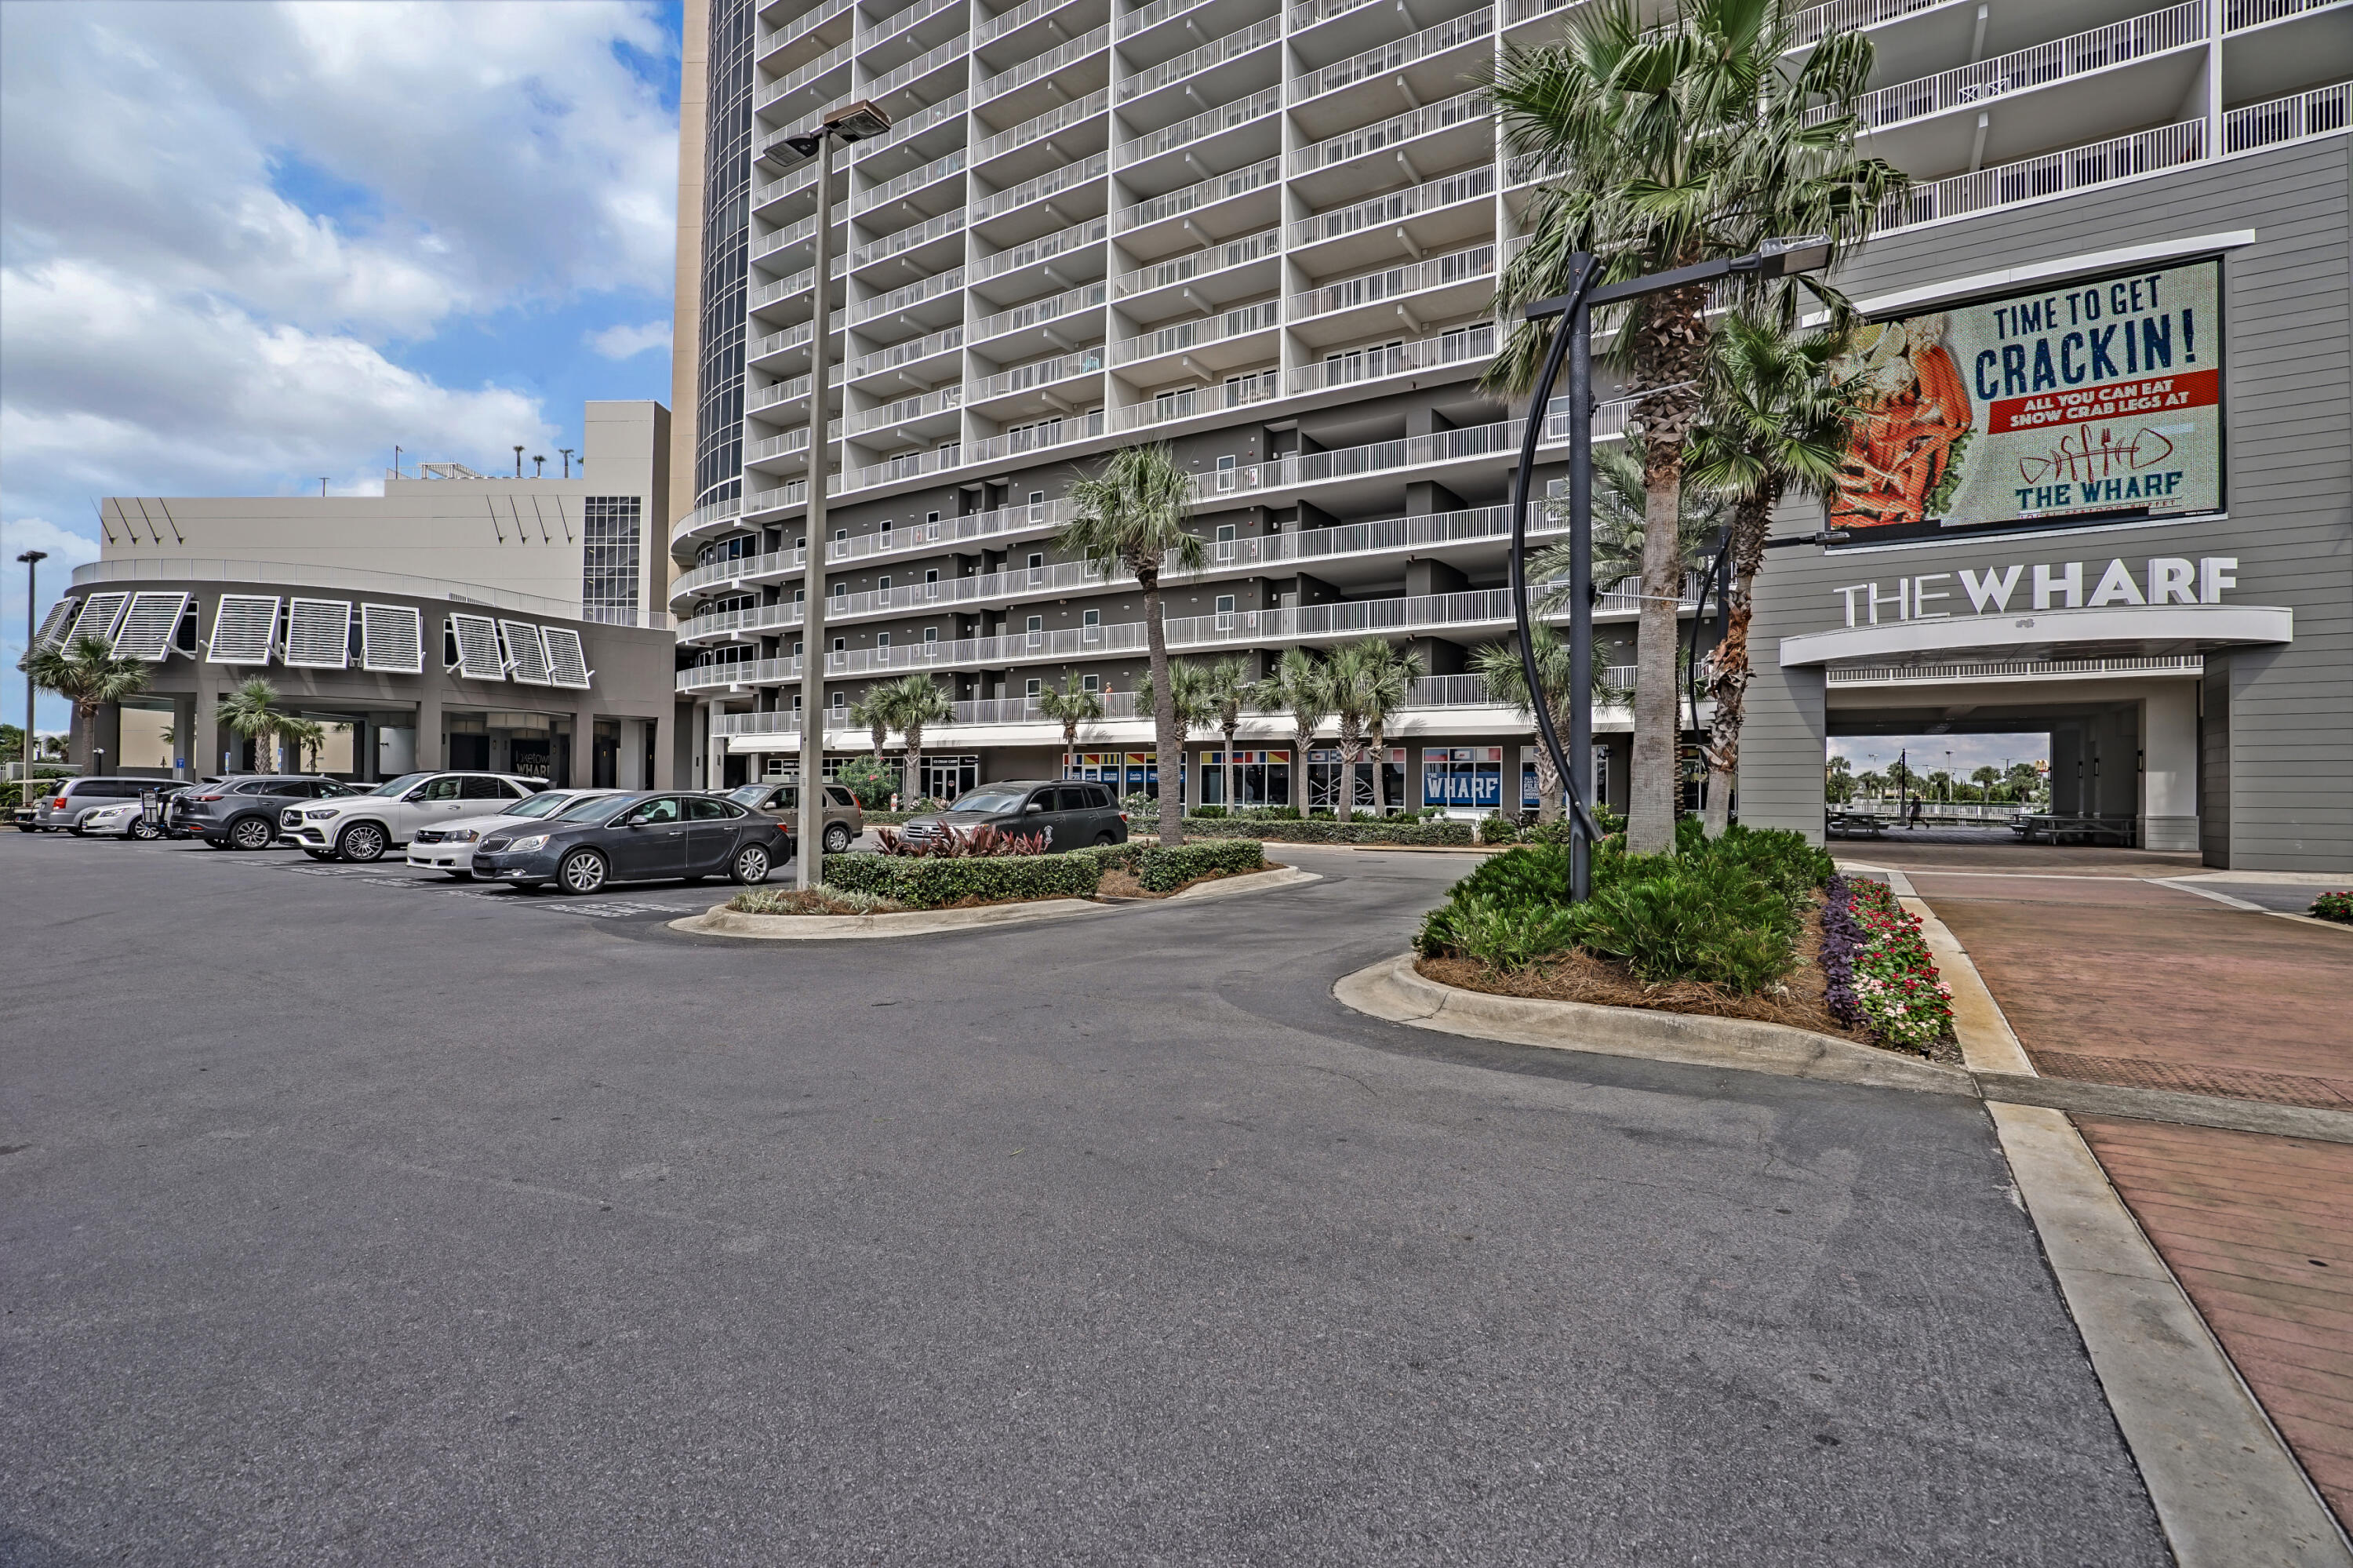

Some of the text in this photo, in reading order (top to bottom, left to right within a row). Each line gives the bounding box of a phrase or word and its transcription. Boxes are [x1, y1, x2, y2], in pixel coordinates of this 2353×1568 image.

[1994, 275, 2161, 340] TIME TO GET
[1976, 308, 2195, 401] CRACKIN!
[2010, 391, 2189, 427] SNOW CRAB LEGS AT
[2024, 380, 2173, 412] ALL YOU CAN EAT
[2015, 471, 2183, 510] THE WHARF
[1833, 556, 2238, 628] THE WHARF
[1427, 777, 1498, 799] WHARF
